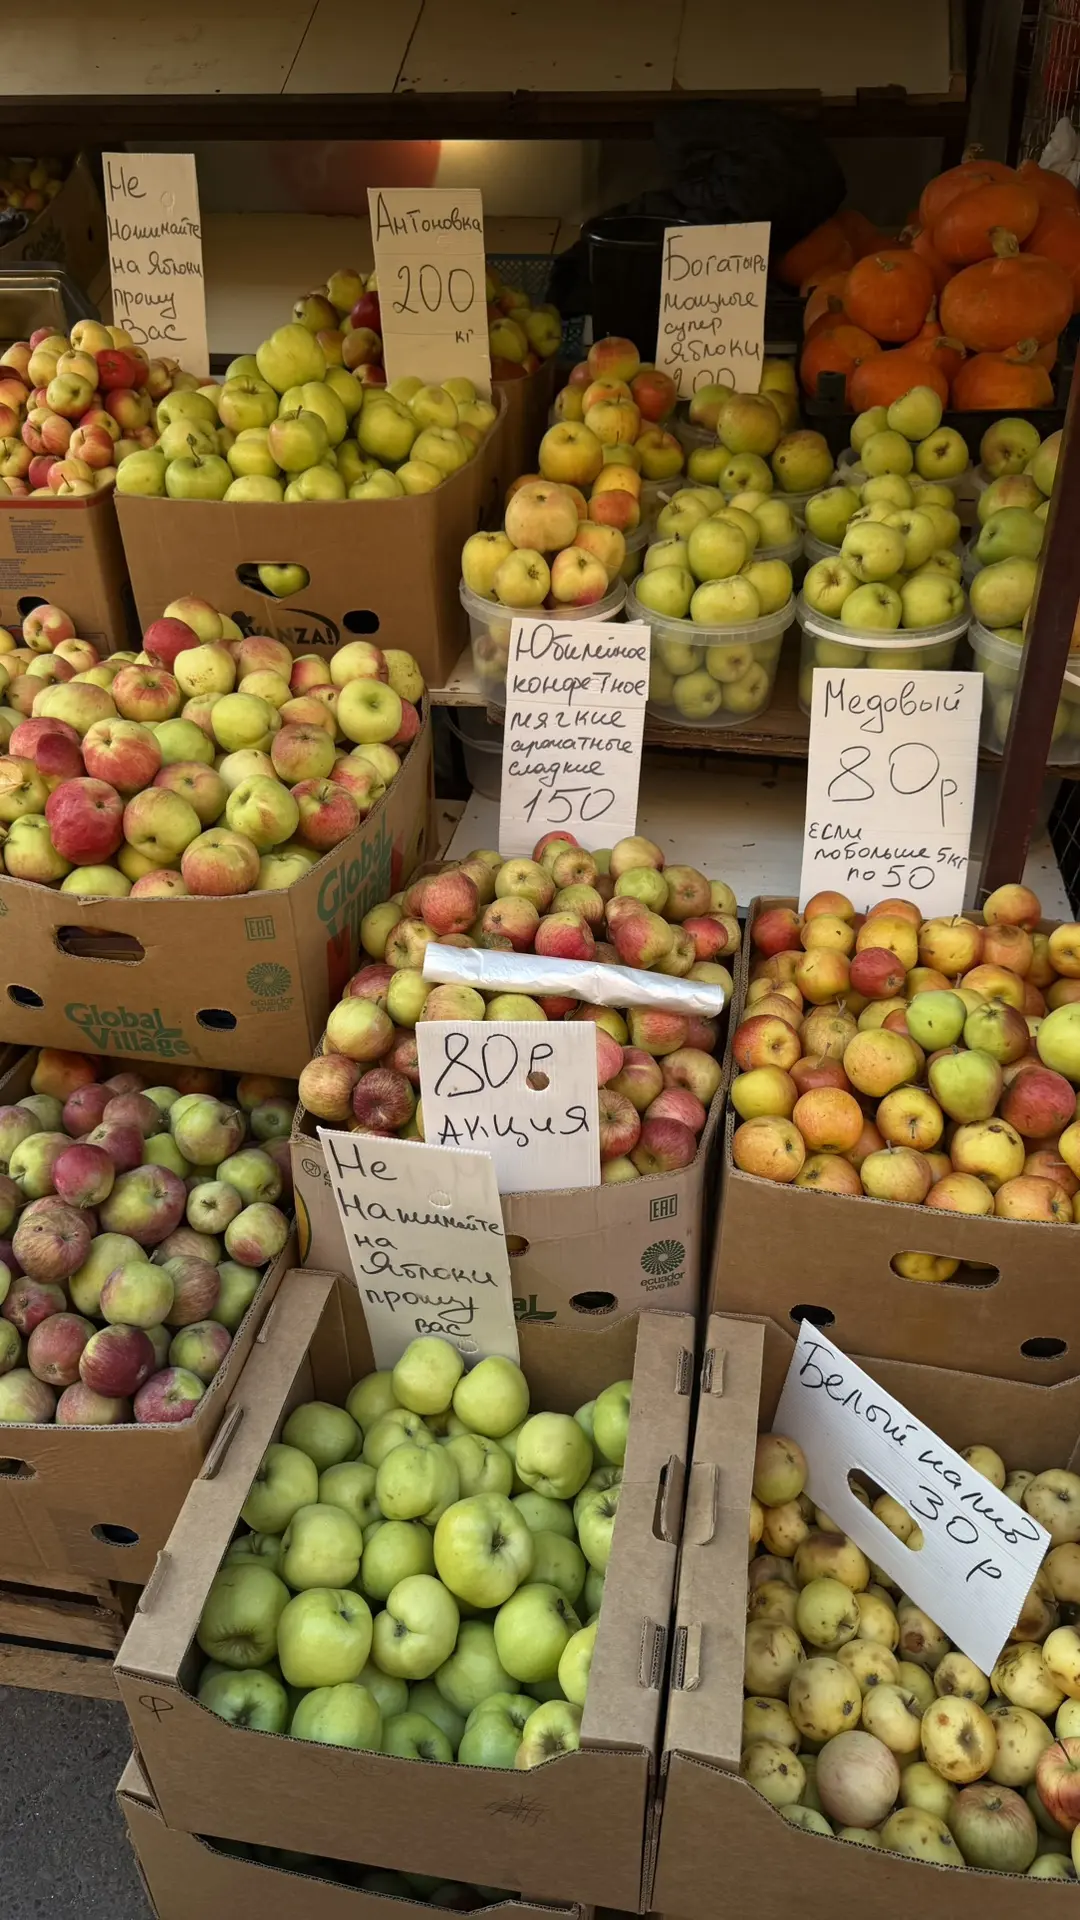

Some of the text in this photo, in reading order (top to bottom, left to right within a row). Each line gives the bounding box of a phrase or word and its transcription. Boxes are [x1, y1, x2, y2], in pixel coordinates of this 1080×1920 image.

[107, 161, 147, 202] Не
[376, 192, 483, 242] Антоновка
[112, 256, 141, 275] на
[664, 234, 767, 281] Богатырь
[113, 288, 177, 320] прошу
[393, 264, 475, 314] 200
[455, 329, 474, 344] кг
[664, 317, 722, 341] супер
[510, 710, 626, 731] мягкие
[824, 678, 965, 733] Медовый
[508, 761, 605, 787] сладкие
[523, 786, 615, 824] 150
[814, 842, 931, 860] побольше
[847, 865, 935, 890] по 50
[64, 1003, 165, 1030] Global
[78, 1025, 191, 1057] Village
[329, 1139, 397, 1180] Не
[354, 1233, 398, 1250] на
[640, 1271, 685, 1286] ecuador
[365, 1289, 479, 1324] прошу
[800, 1340, 918, 1447] Белый
